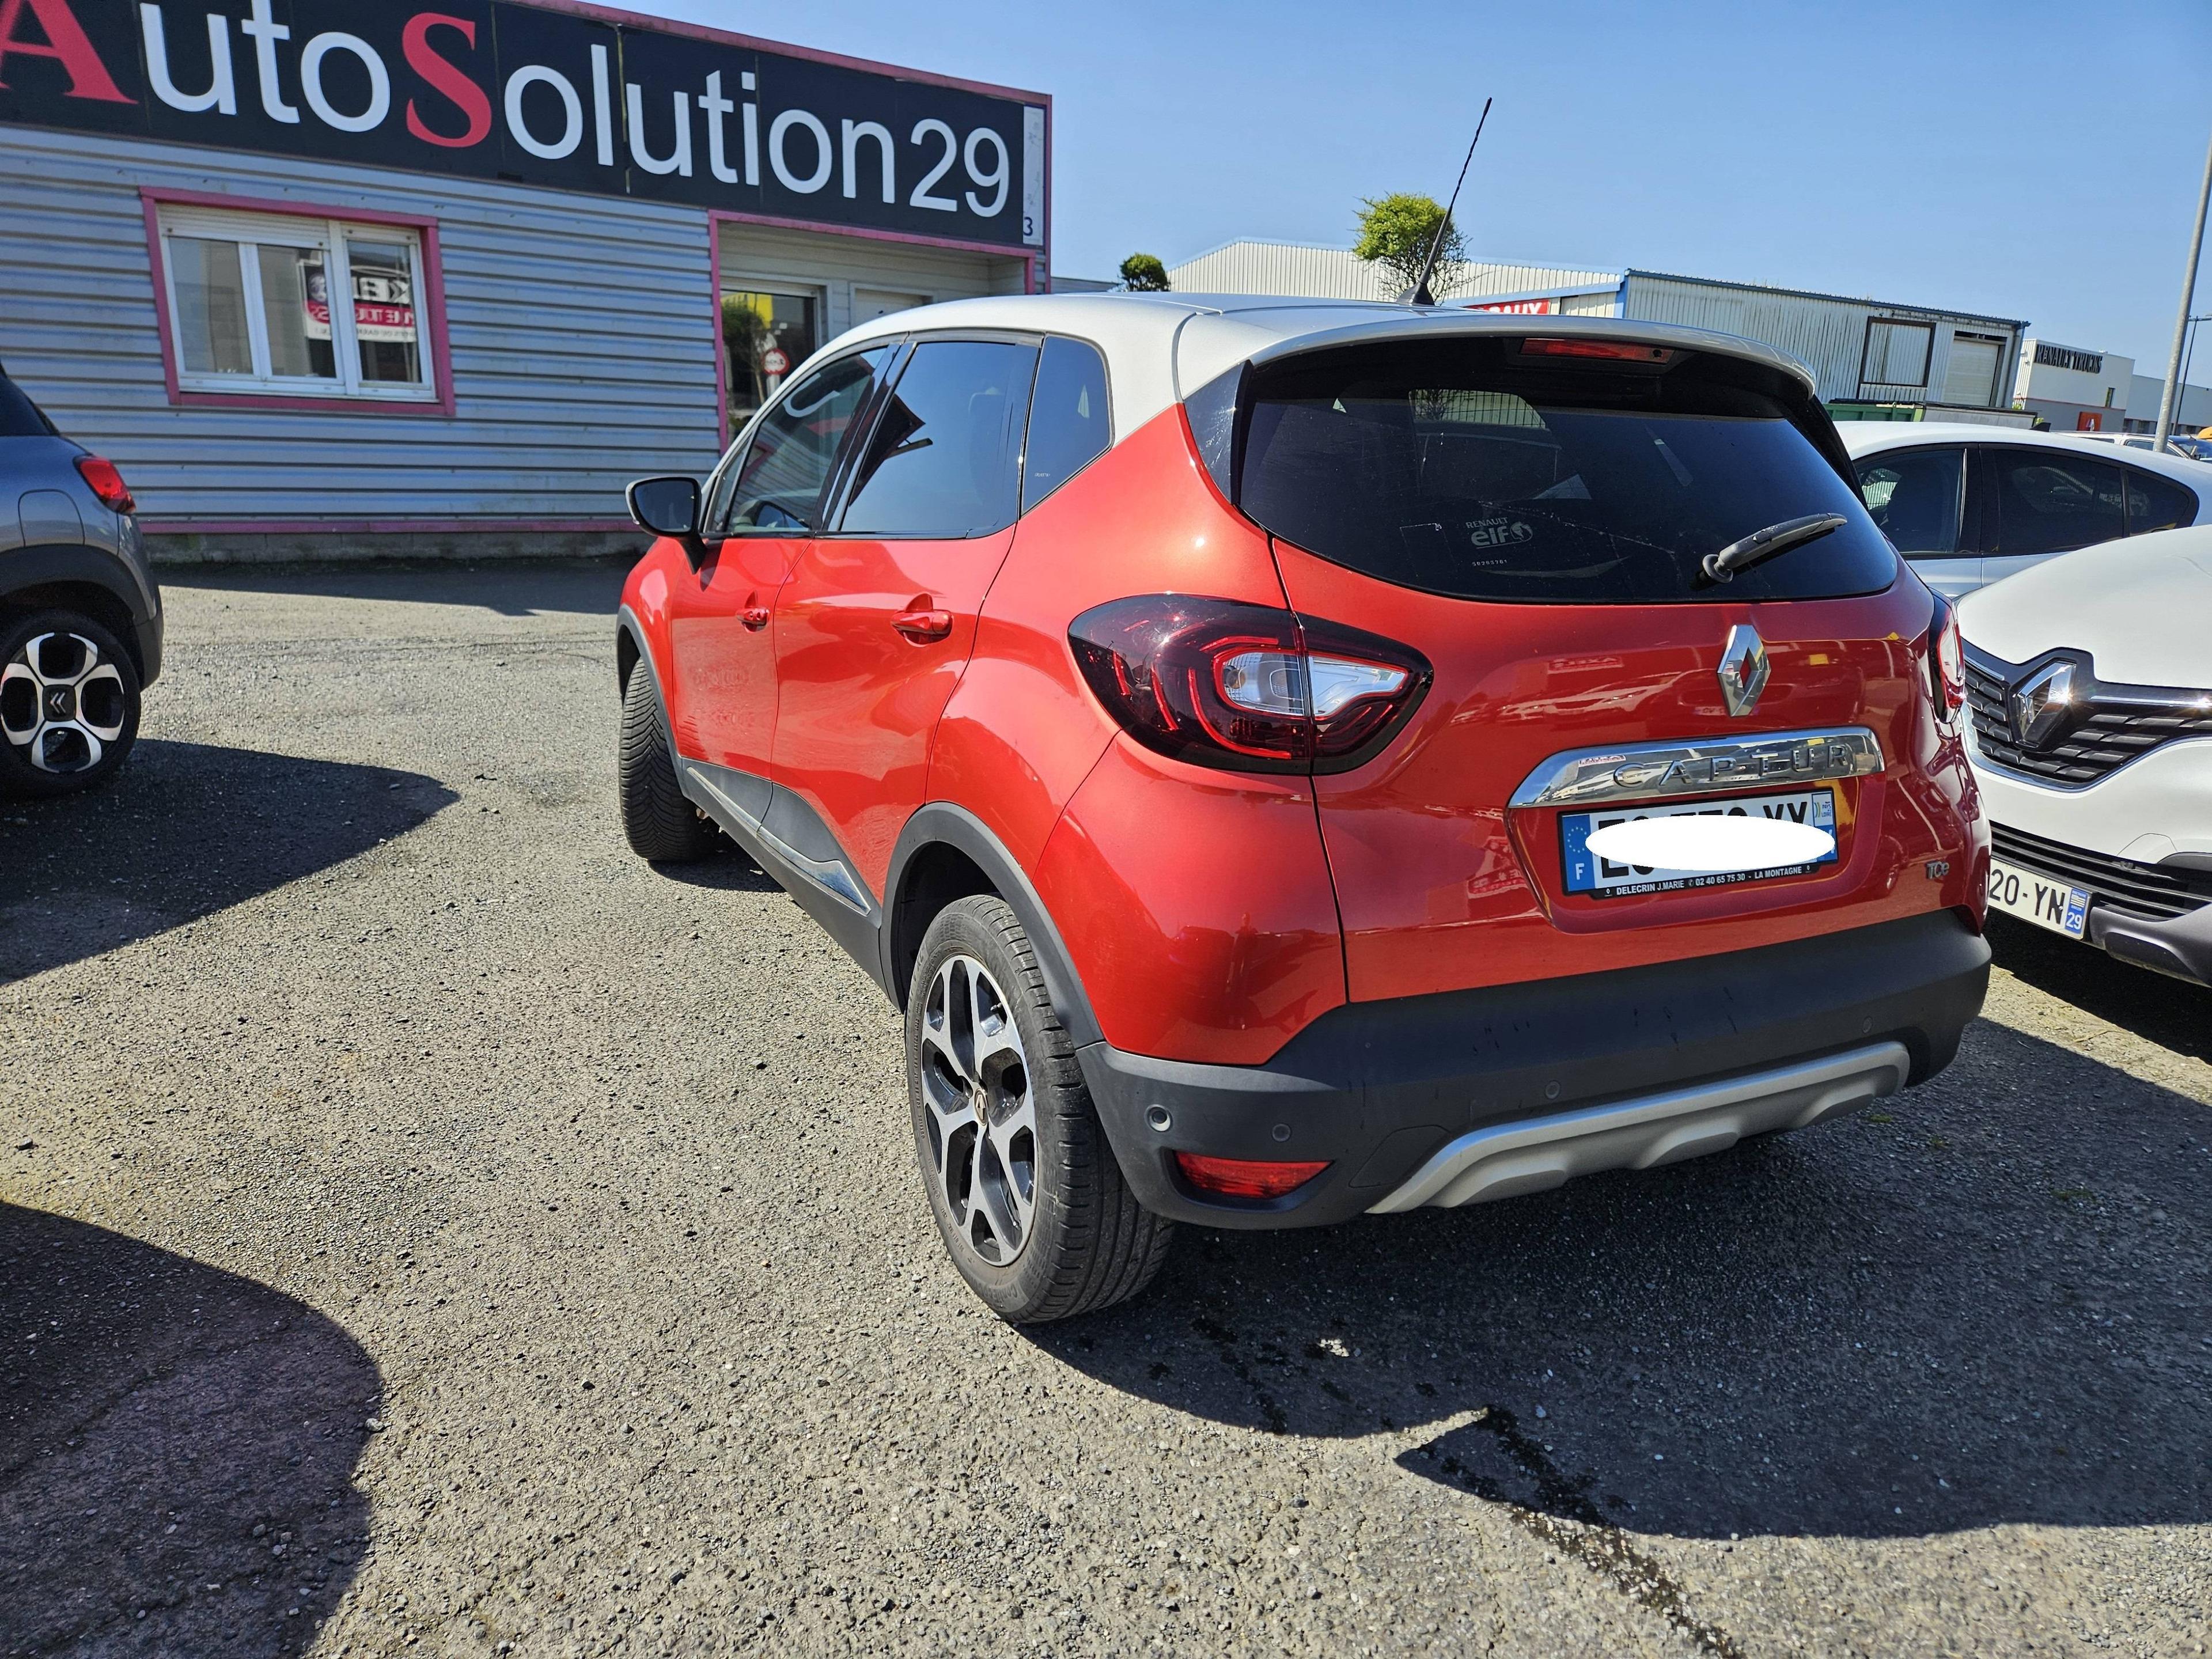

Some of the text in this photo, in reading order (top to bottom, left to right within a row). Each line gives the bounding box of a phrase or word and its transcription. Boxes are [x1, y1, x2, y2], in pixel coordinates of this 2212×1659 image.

[2033, 344, 2103, 374] RENAULT TRUCKS
[1465, 517, 1508, 528] RENAULT
[1471, 526, 1509, 546] elf
[1613, 743, 1848, 788] CAPTUR
[1575, 863, 1585, 881] F
[1927, 861, 1949, 879] TCe
[1616, 883, 1656, 895] DELECRIN
[1657, 880, 1685, 891] J.MARIE
[1695, 878, 1705, 887] 02
[1706, 876, 1715, 885] 40
[1717, 875, 1725, 884] 65
[1727, 874, 1736, 882] 75
[1737, 873, 1745, 881] 30
[1755, 871, 1764, 879] LA
[1765, 866, 1802, 878] MONTAGNE
[2066, 911, 2083, 930] 29
